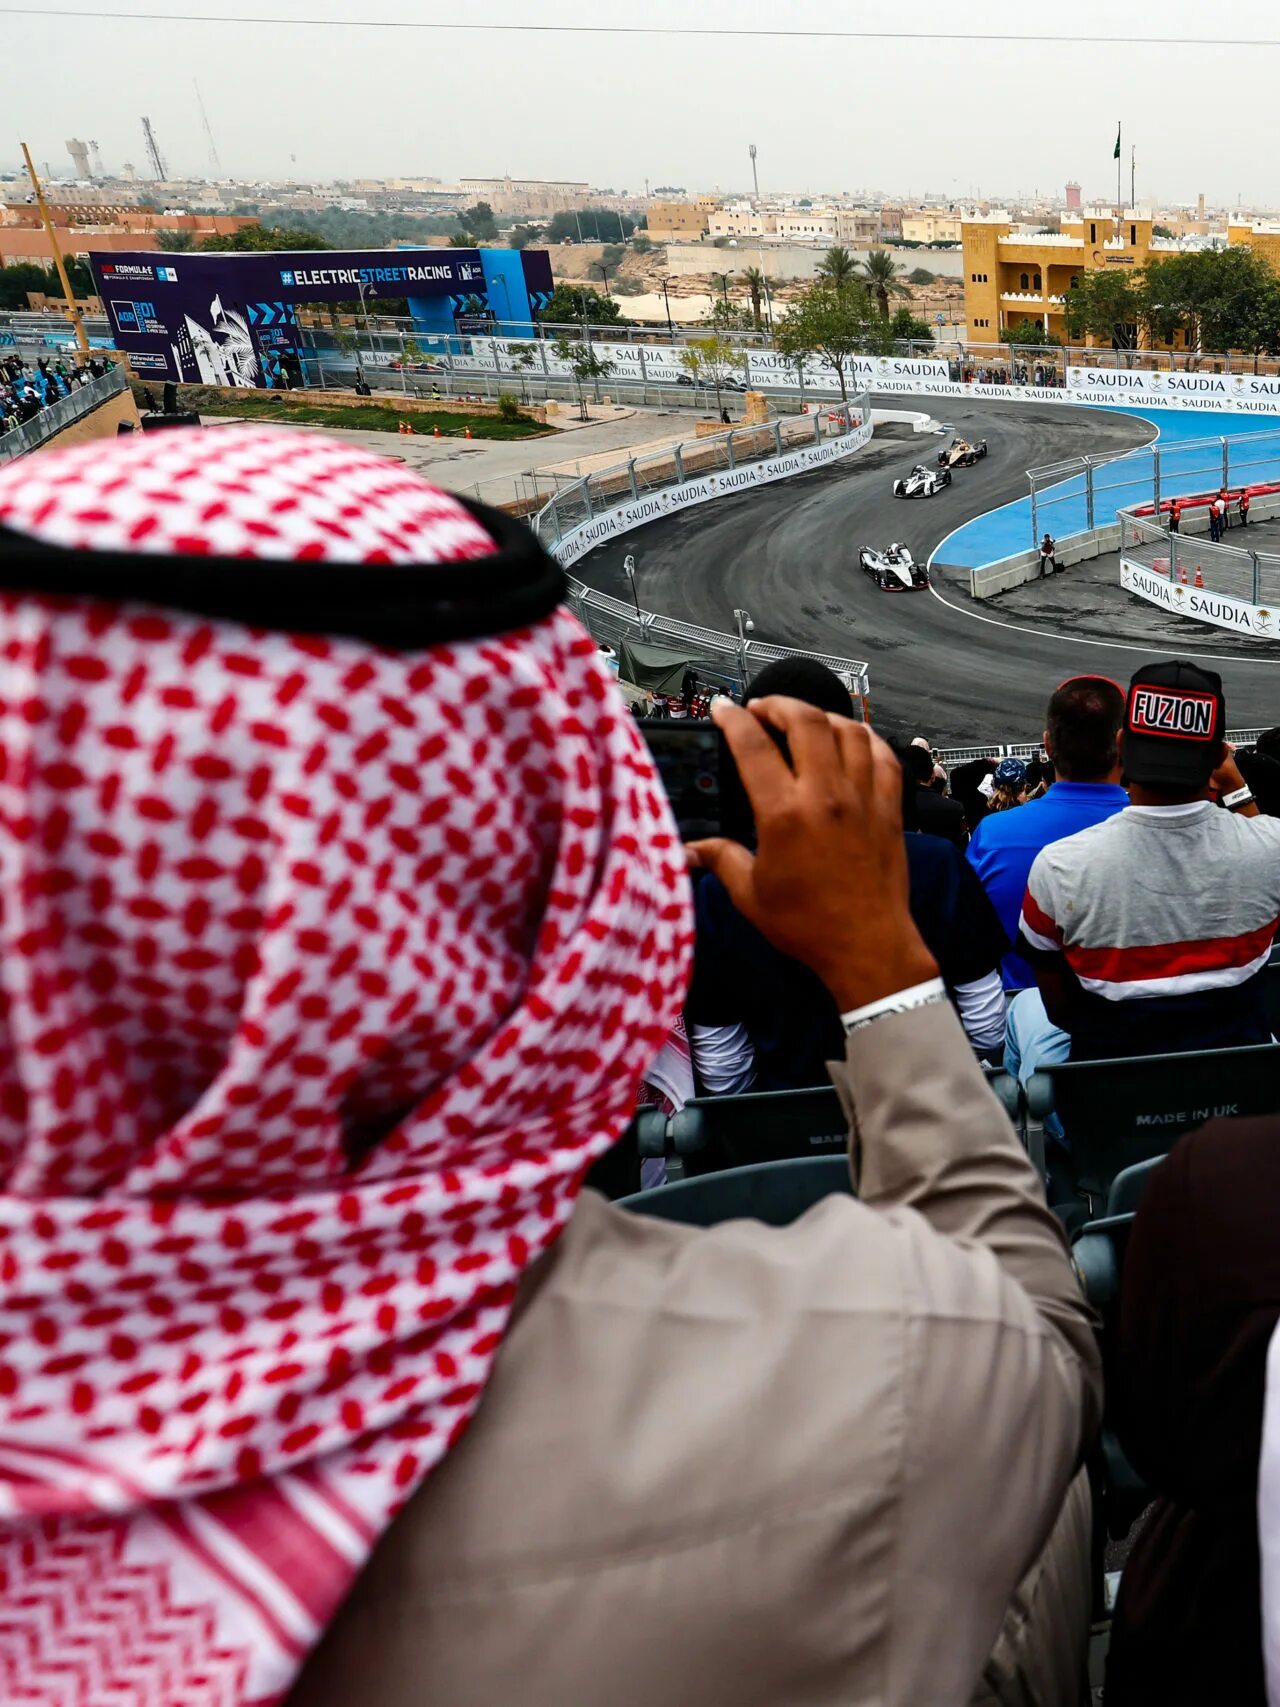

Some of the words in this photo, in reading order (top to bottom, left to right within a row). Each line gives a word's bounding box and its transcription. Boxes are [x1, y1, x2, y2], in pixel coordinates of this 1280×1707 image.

[282, 266, 452, 286] #ELECTRICSTREETRACING
[140, 302, 156, 318] 01
[616, 350, 664, 362] SAUDIA
[752, 356, 798, 370] SAUDI
[822, 360, 872, 372] SUDIA
[894, 363, 946, 376] SAUDIA
[479, 360, 510, 369] SAUIA
[608, 366, 636, 376] AUDIA
[783, 377, 818, 386] SAUIA
[830, 380, 864, 388] SAUDA
[876, 382, 912, 391] SAUDIA
[924, 384, 962, 394] SAUDIA
[974, 386, 1012, 397] SAUDIA
[1024, 390, 1062, 400] SAUDIA
[1076, 392, 1114, 402] SAUDIA
[1128, 396, 1168, 406] SAUDIA
[1182, 398, 1222, 408] SAUDIA
[1236, 402, 1276, 412] SAUDIA
[1087, 374, 1144, 388] SAUDIA
[1168, 378, 1225, 392] SAUDIA
[558, 542, 580, 566] SAUDIA
[586, 518, 616, 544] SAUDIA
[626, 500, 661, 523] SAUDIA
[671, 485, 708, 506] SAUDIA
[719, 470, 756, 490] SAUDIA
[767, 459, 799, 476] SAUDIA
[808, 448, 834, 464] SAUDIA
[1132, 573, 1170, 604] SAUDIA
[1190, 596, 1250, 627] SAUDIA
[1132, 690, 1212, 734] FUZION
[1136, 1111, 1188, 1127] MADE
[1192, 1108, 1209, 1120] IN
[1214, 1104, 1239, 1117] UK
